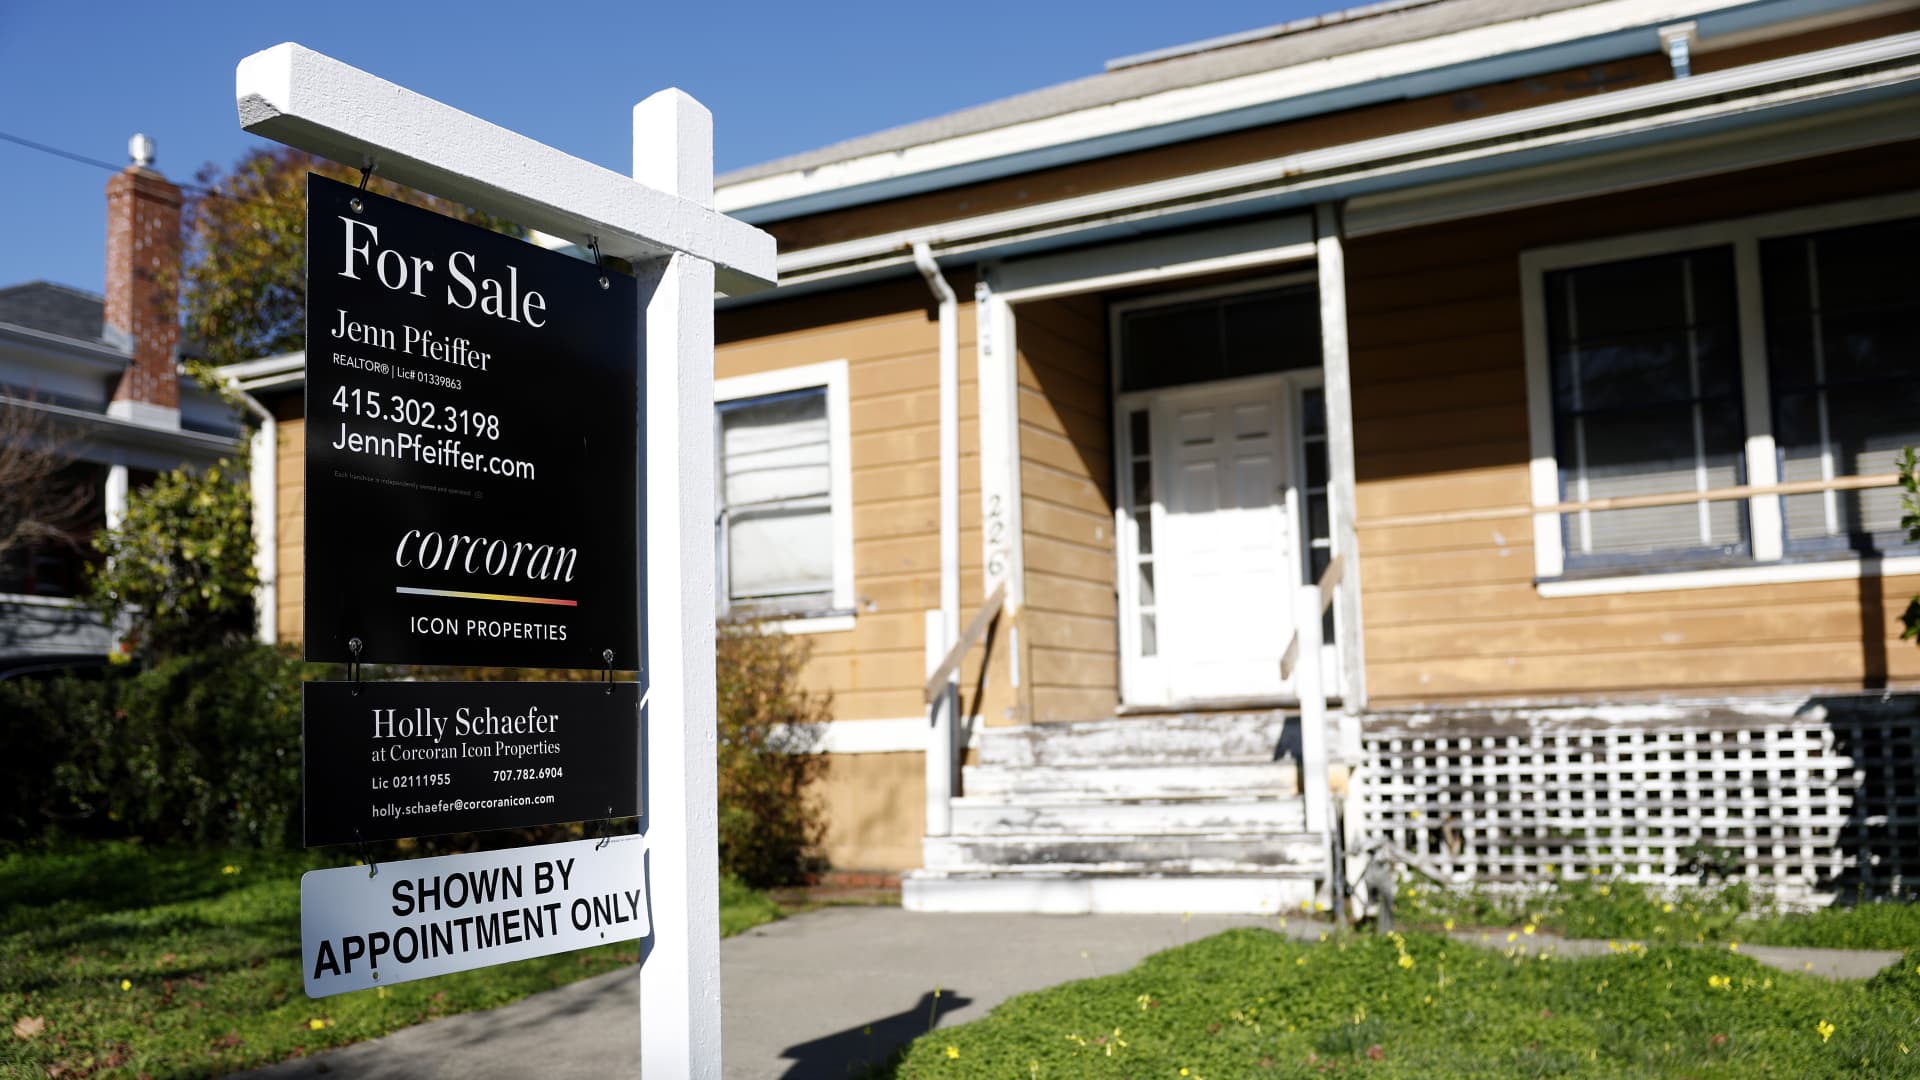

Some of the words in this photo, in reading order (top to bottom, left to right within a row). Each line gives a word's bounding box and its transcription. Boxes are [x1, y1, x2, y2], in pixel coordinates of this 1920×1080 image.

[337, 215, 434, 298] For
[447, 251, 546, 328] Sale
[331, 309, 395, 350] Jenn
[402, 325, 491, 371] Pfeiffer
[397, 366, 415, 380] Lic#
[417, 371, 462, 390] 01339863
[332, 385, 500, 440] 415.302.3198
[332, 422, 535, 480] JennPfeiffer.com
[395, 529, 577, 582] corcoran
[411, 616, 458, 635] ICON
[467, 619, 567, 641] PROPERTIES
[372, 707, 449, 744] Holly
[455, 706, 559, 736] Schaefer
[372, 746, 386, 762] at
[390, 744, 457, 761] Corcoran
[462, 742, 492, 758] Icon
[495, 740, 561, 759] Properties
[372, 777, 389, 790] Lic
[393, 773, 451, 789] 02111955
[493, 767, 563, 782] 707.782.6904
[372, 794, 555, 819] holly.schaefer@corcoranicon.com
[391, 864, 523, 917] SHOWN
[534, 857, 576, 895] BY
[313, 902, 562, 980] APPOINTMENT
[571, 888, 641, 931] ONLY
